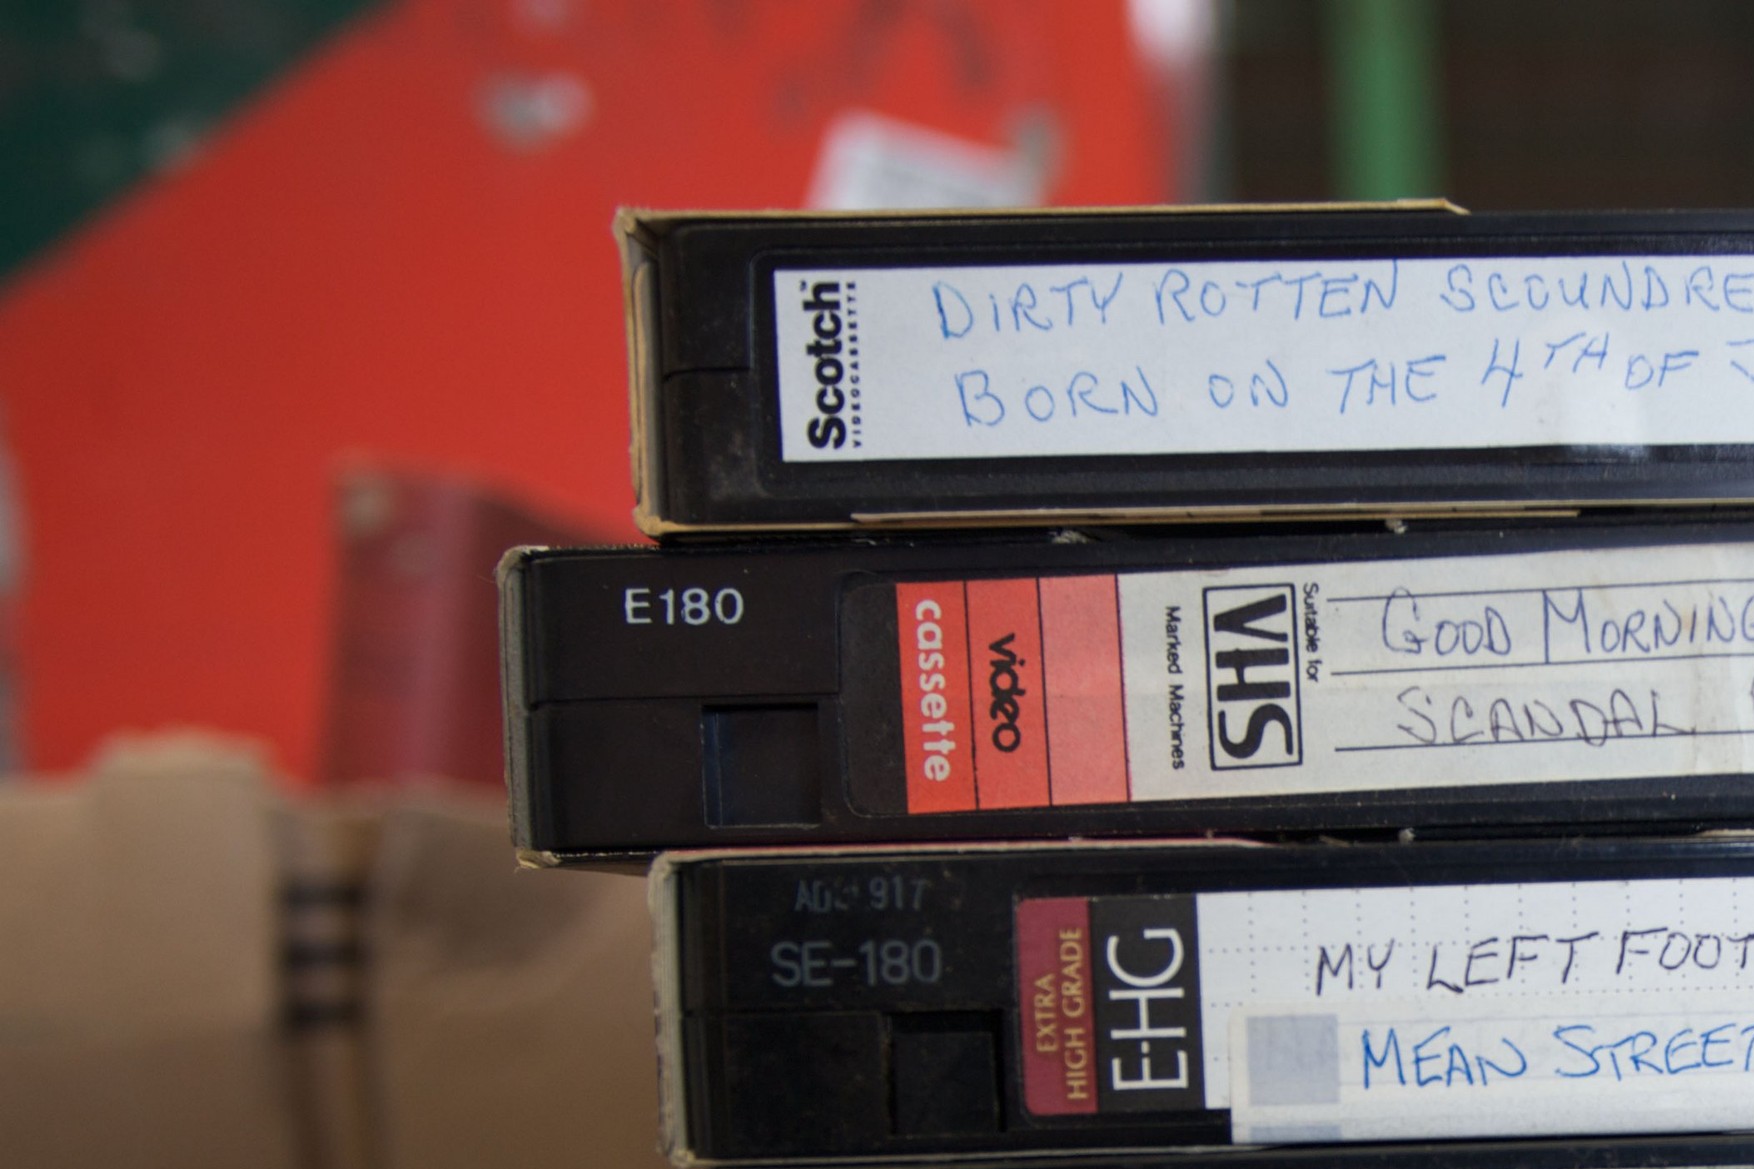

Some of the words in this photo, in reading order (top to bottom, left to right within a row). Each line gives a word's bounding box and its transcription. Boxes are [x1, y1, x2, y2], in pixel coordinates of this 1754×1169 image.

[931, 271, 1124, 341] DIRTY
[1155, 259, 1399, 326] ROTTEN
[804, 281, 846, 450] Scotch
[847, 281, 864, 449] VIDEOCASSETTE
[956, 366, 1159, 427] BORN
[1209, 358, 1290, 410] ON
[1330, 355, 1446, 415] THE
[1625, 350, 1700, 390] OF
[623, 587, 745, 626] E180
[1164, 604, 1183, 675] Marked
[1303, 581, 1320, 652] Suitable
[1381, 587, 1512, 656] GOOD
[914, 599, 952, 782] cassette
[988, 633, 1021, 754] video
[1212, 594, 1297, 759] VHS
[1306, 659, 1321, 683] for
[1168, 683, 1187, 771] Machines
[1397, 686, 1697, 747] SCANDAL
[769, 938, 944, 989] SE-180
[1058, 926, 1088, 1022] GRADE
[1316, 936, 1396, 998] MY
[1426, 930, 1598, 994] LEFT
[1035, 972, 1059, 1055] EXTRA
[1064, 1028, 1090, 1102] HIGH
[1361, 1026, 1528, 1090] MEAN
